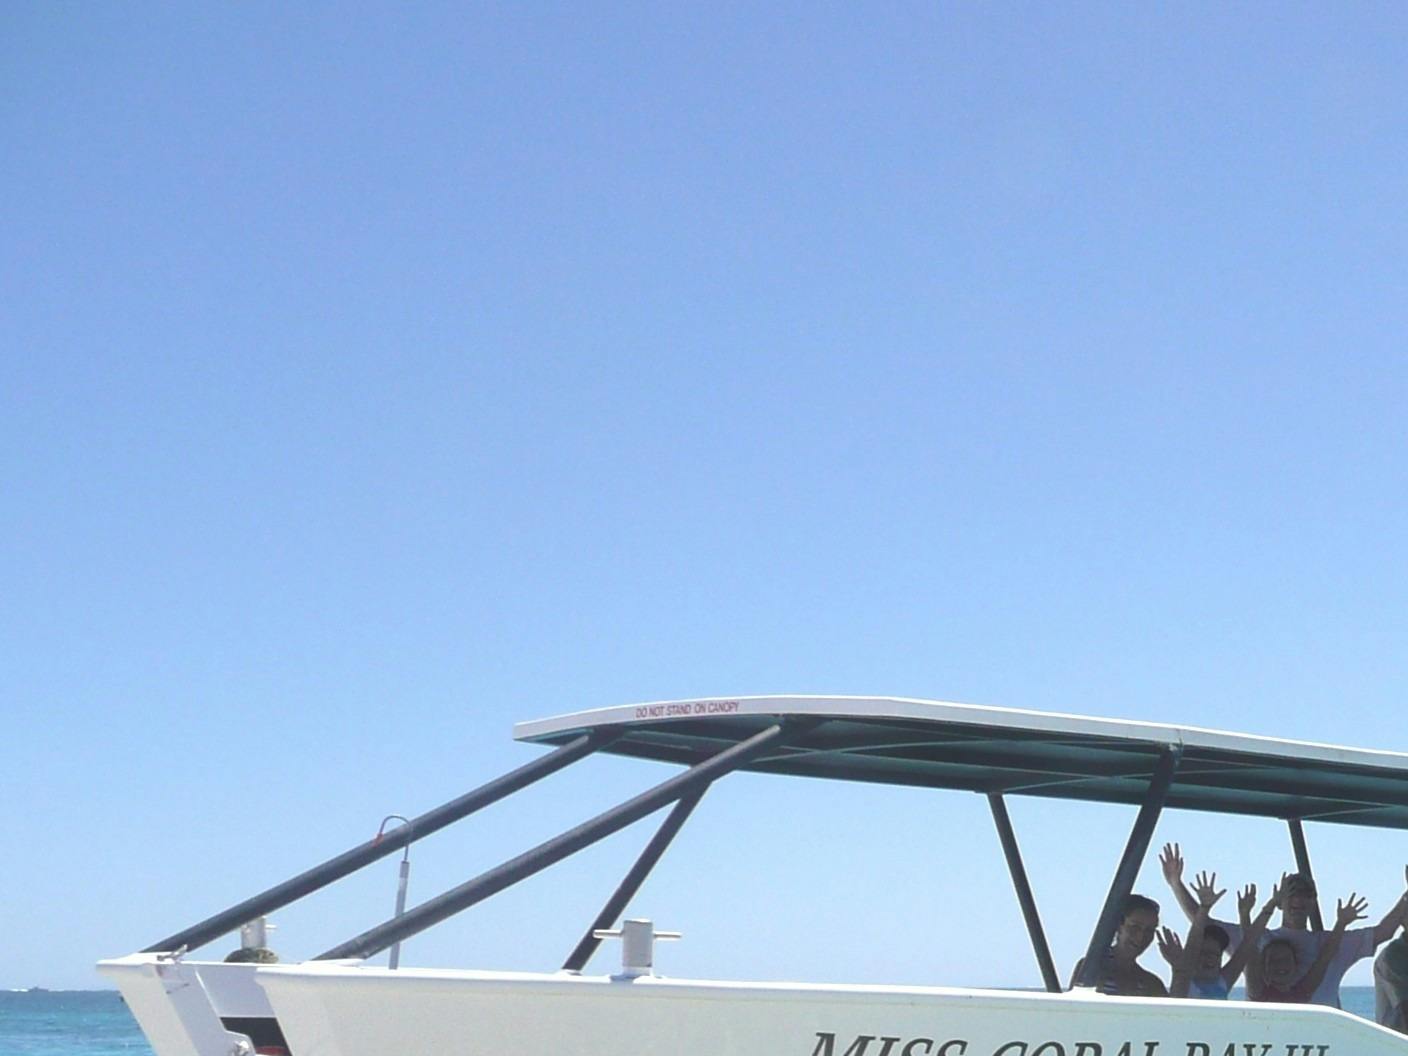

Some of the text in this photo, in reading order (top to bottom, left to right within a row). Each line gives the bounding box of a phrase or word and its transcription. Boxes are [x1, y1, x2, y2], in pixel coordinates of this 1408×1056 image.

[636, 701, 739, 718] DO NOT STAND ON CANOPY
